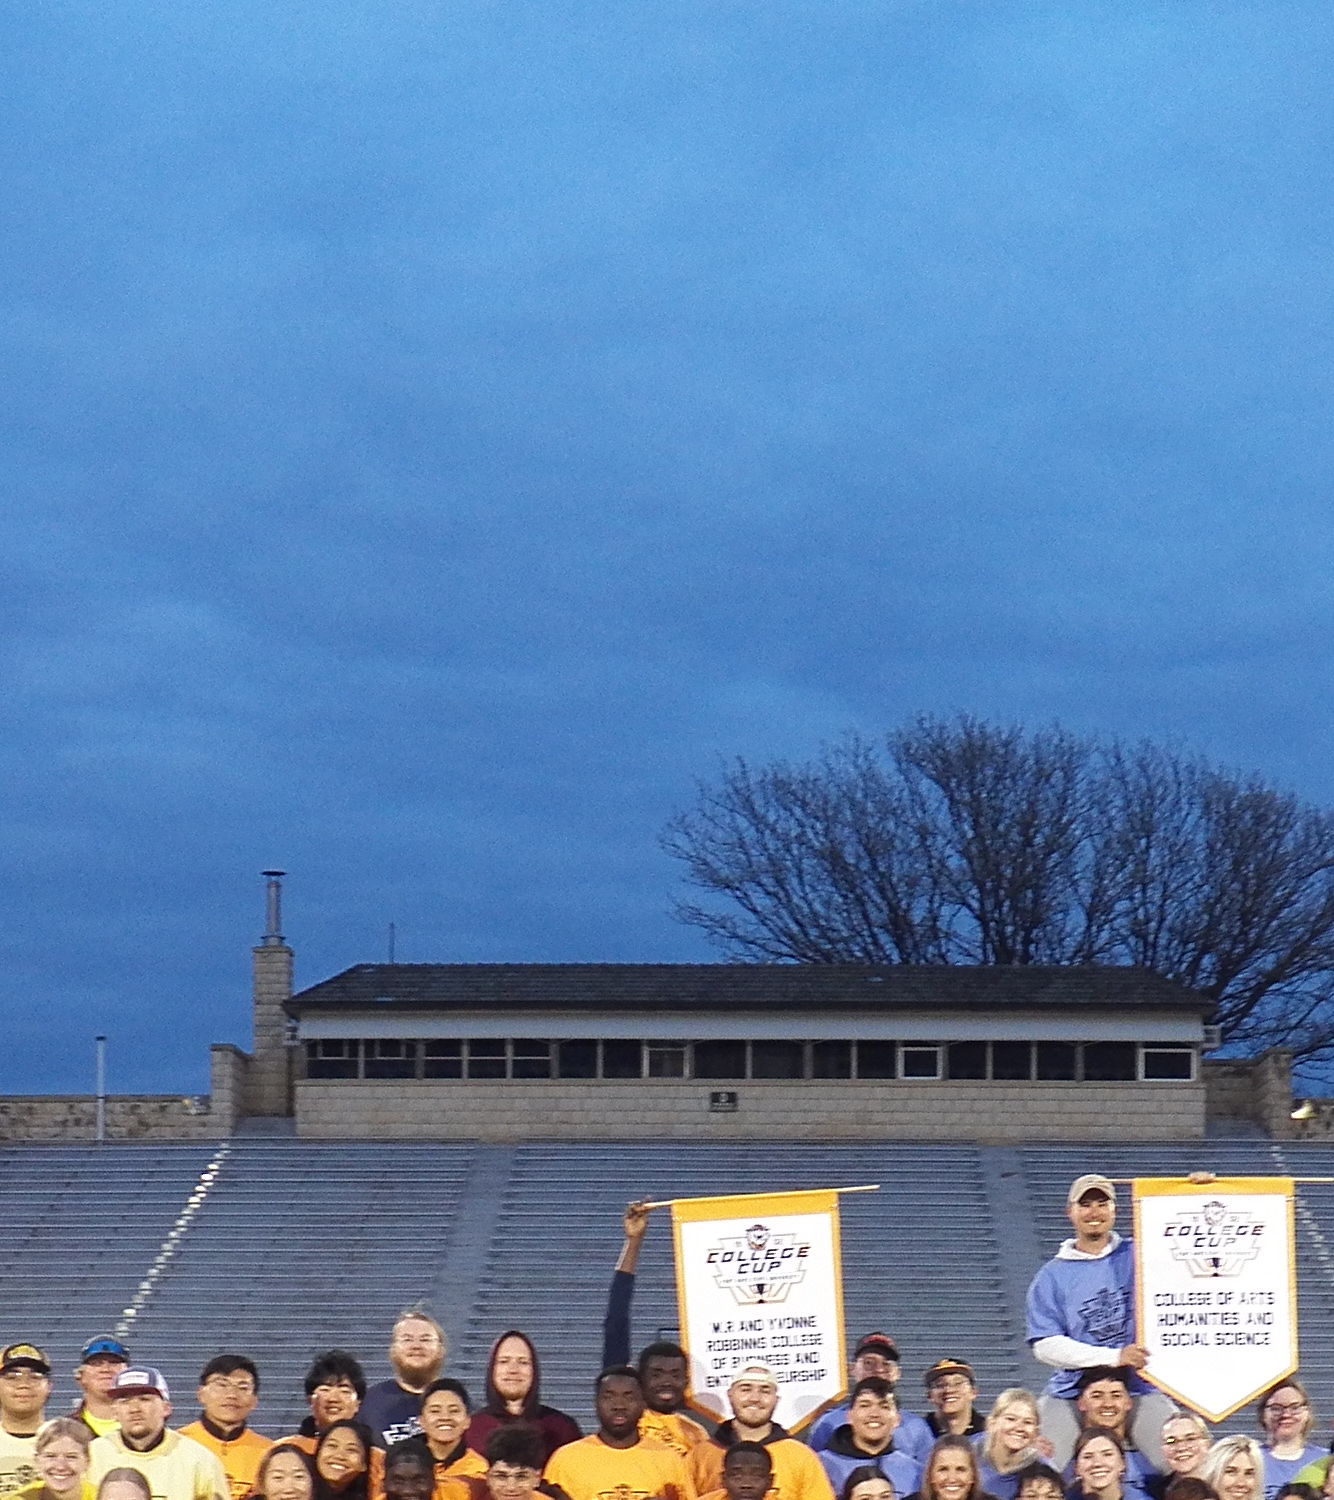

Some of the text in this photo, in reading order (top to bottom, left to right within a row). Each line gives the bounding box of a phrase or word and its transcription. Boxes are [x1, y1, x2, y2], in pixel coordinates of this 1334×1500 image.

[1163, 1225, 1266, 1237] COLLEGE
[1194, 1237, 1237, 1248] CUP
[706, 1246, 811, 1263] COLLEGE
[737, 1261, 782, 1274] CUP
[1153, 1292, 1275, 1306] COLLEGE OF ARTS
[738, 1319, 764, 1331] AND
[767, 1315, 818, 1331] YVONNE
[1157, 1312, 1274, 1326] HUMANITIES AND
[771, 1333, 824, 1348] COLLEGE
[1160, 1332, 1271, 1346] SOCIAL SCIENCE
[712, 1357, 728, 1369] OF
[794, 1351, 820, 1364] AND
